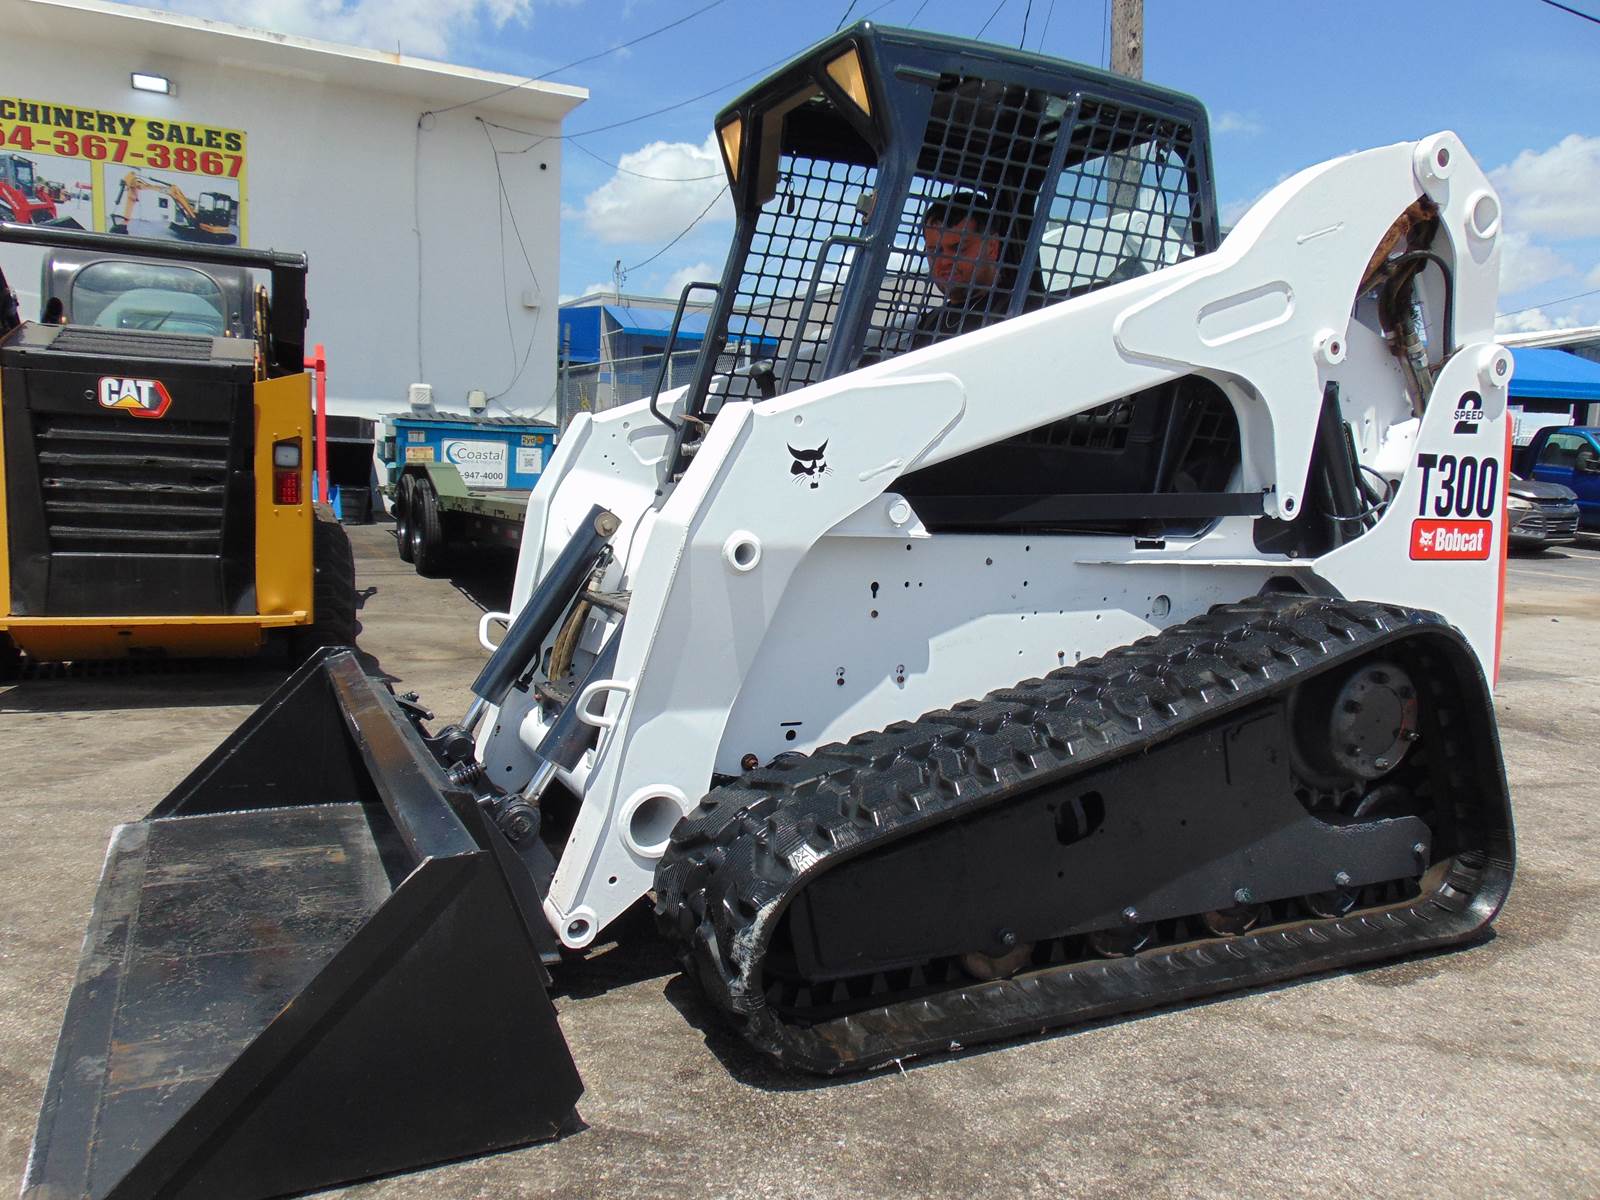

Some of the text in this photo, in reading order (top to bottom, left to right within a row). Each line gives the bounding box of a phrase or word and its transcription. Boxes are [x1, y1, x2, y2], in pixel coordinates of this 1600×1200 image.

[0, 122, 243, 178] 4-367-3867
[147, 121, 242, 151] SALES
[101, 377, 155, 408] CAT
[1453, 390, 1483, 434] 2
[1454, 410, 1484, 420] SPEED
[457, 447, 504, 460] Coastal
[459, 471, 504, 480] -947-4000
[1417, 453, 1499, 518] T300
[1434, 527, 1485, 552] Bobcat
